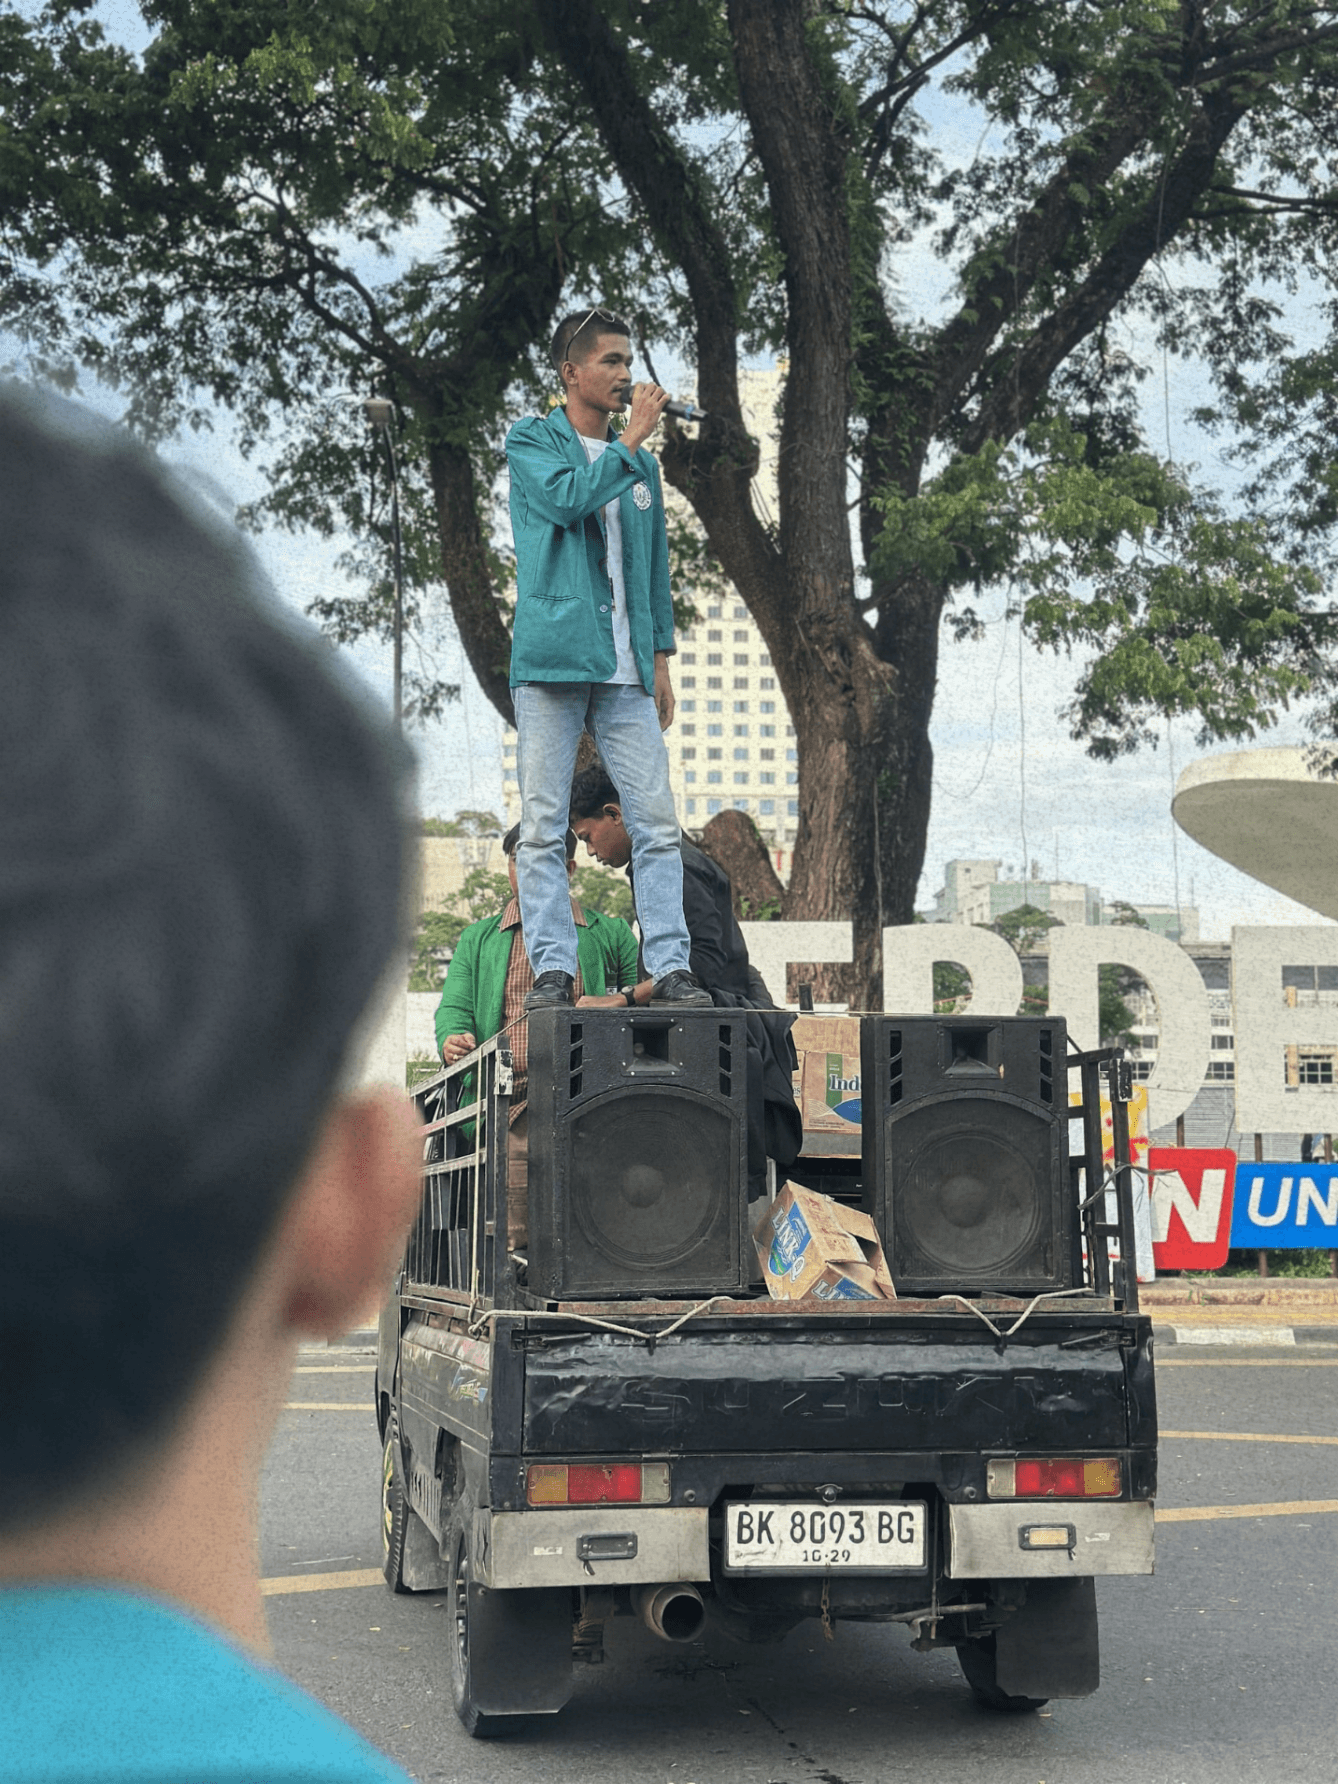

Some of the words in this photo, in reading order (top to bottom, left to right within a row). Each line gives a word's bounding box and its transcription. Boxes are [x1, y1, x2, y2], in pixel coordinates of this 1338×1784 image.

[1151, 1168, 1227, 1243] N
[1248, 1176, 1338, 1227] UN
[737, 1511, 775, 1544] BK
[789, 1511, 865, 1544] 8093
[878, 1511, 915, 1544] BG
